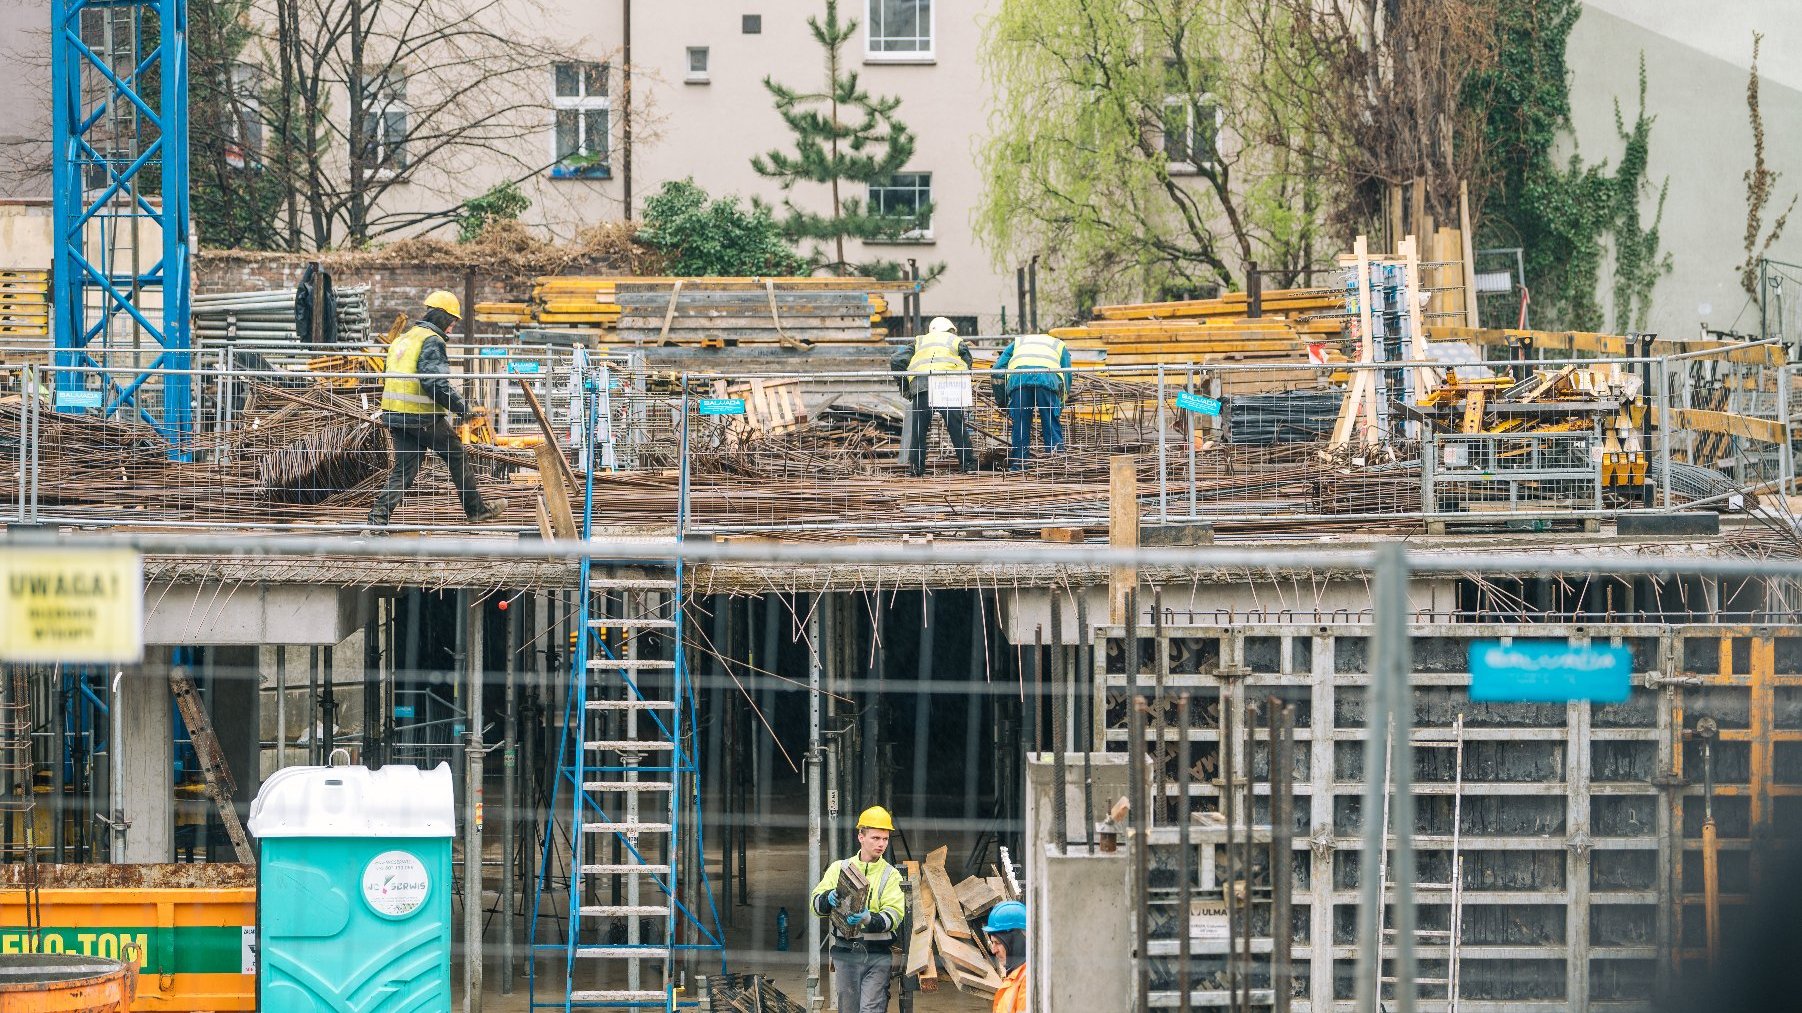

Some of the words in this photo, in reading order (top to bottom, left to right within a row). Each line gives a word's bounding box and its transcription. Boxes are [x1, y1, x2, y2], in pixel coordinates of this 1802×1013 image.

[391, 882, 426, 891] SERWIS
[1202, 908, 1228, 917] ULMA
[2, 933, 148, 968] EKO-TOM
